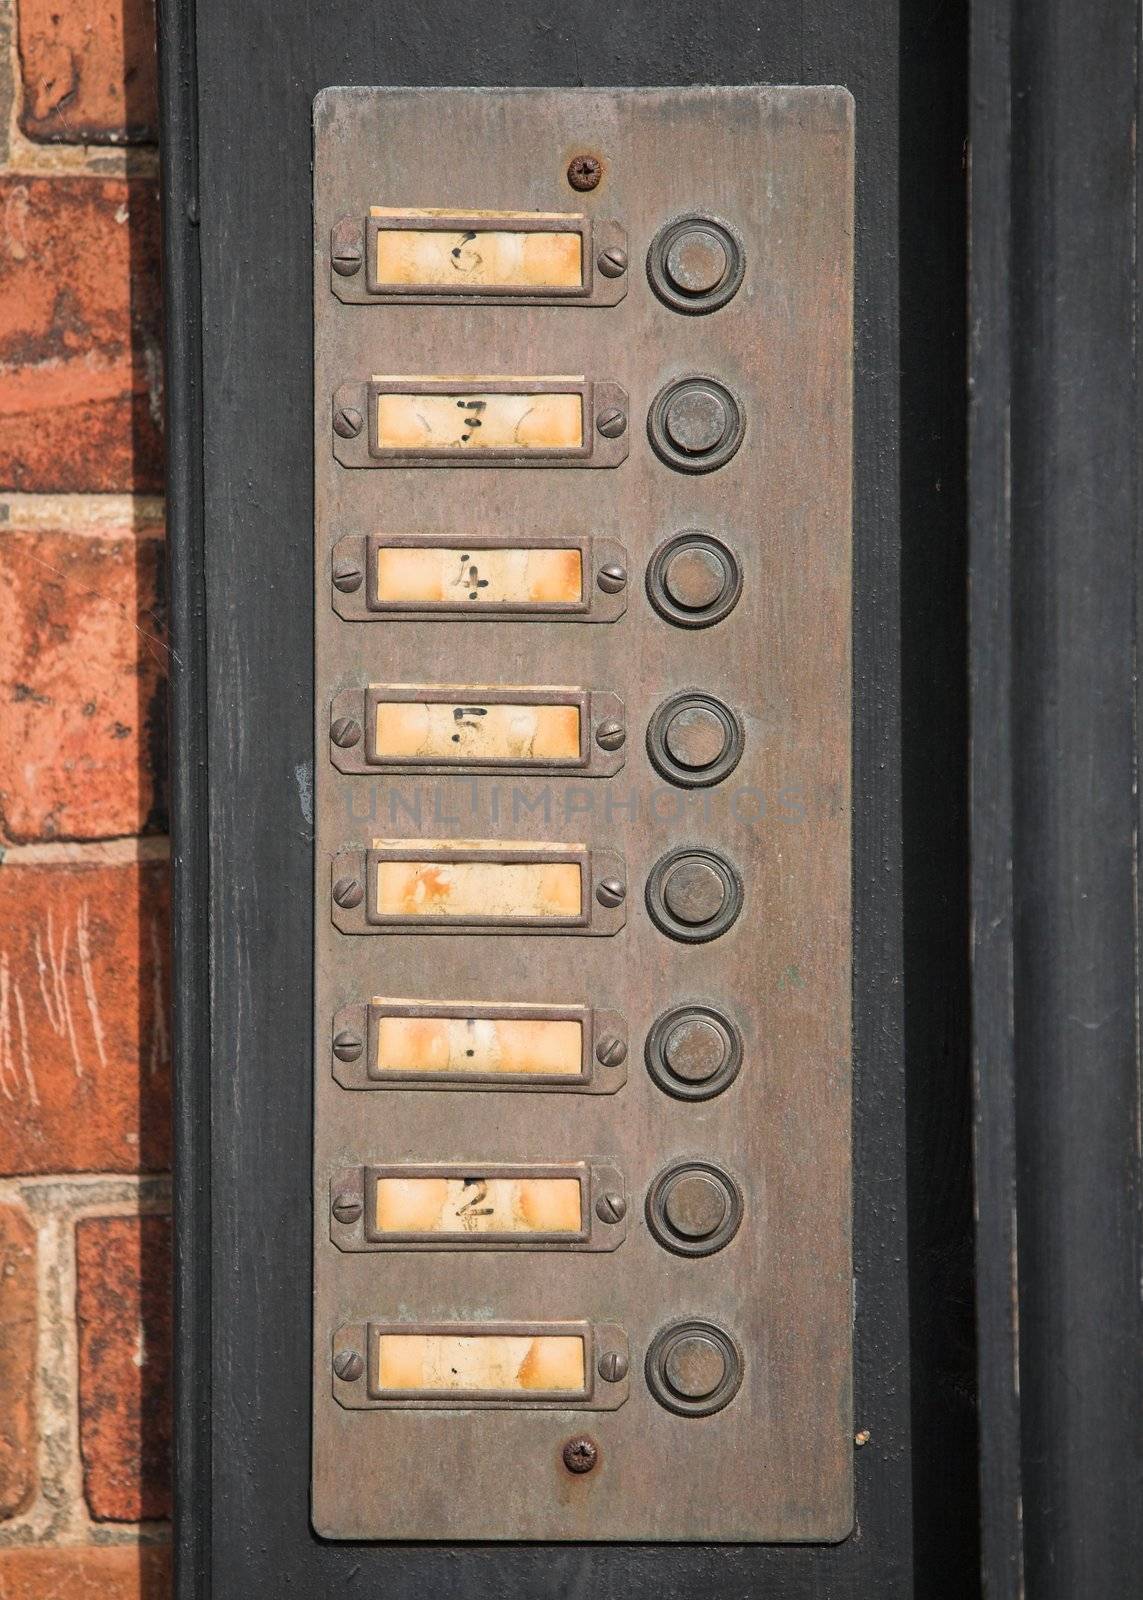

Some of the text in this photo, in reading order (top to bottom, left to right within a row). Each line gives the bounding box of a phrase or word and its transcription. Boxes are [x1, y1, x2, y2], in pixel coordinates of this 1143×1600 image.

[456, 401, 487, 442] 7
[451, 554, 489, 600] 4
[456, 1178, 494, 1217] 2
